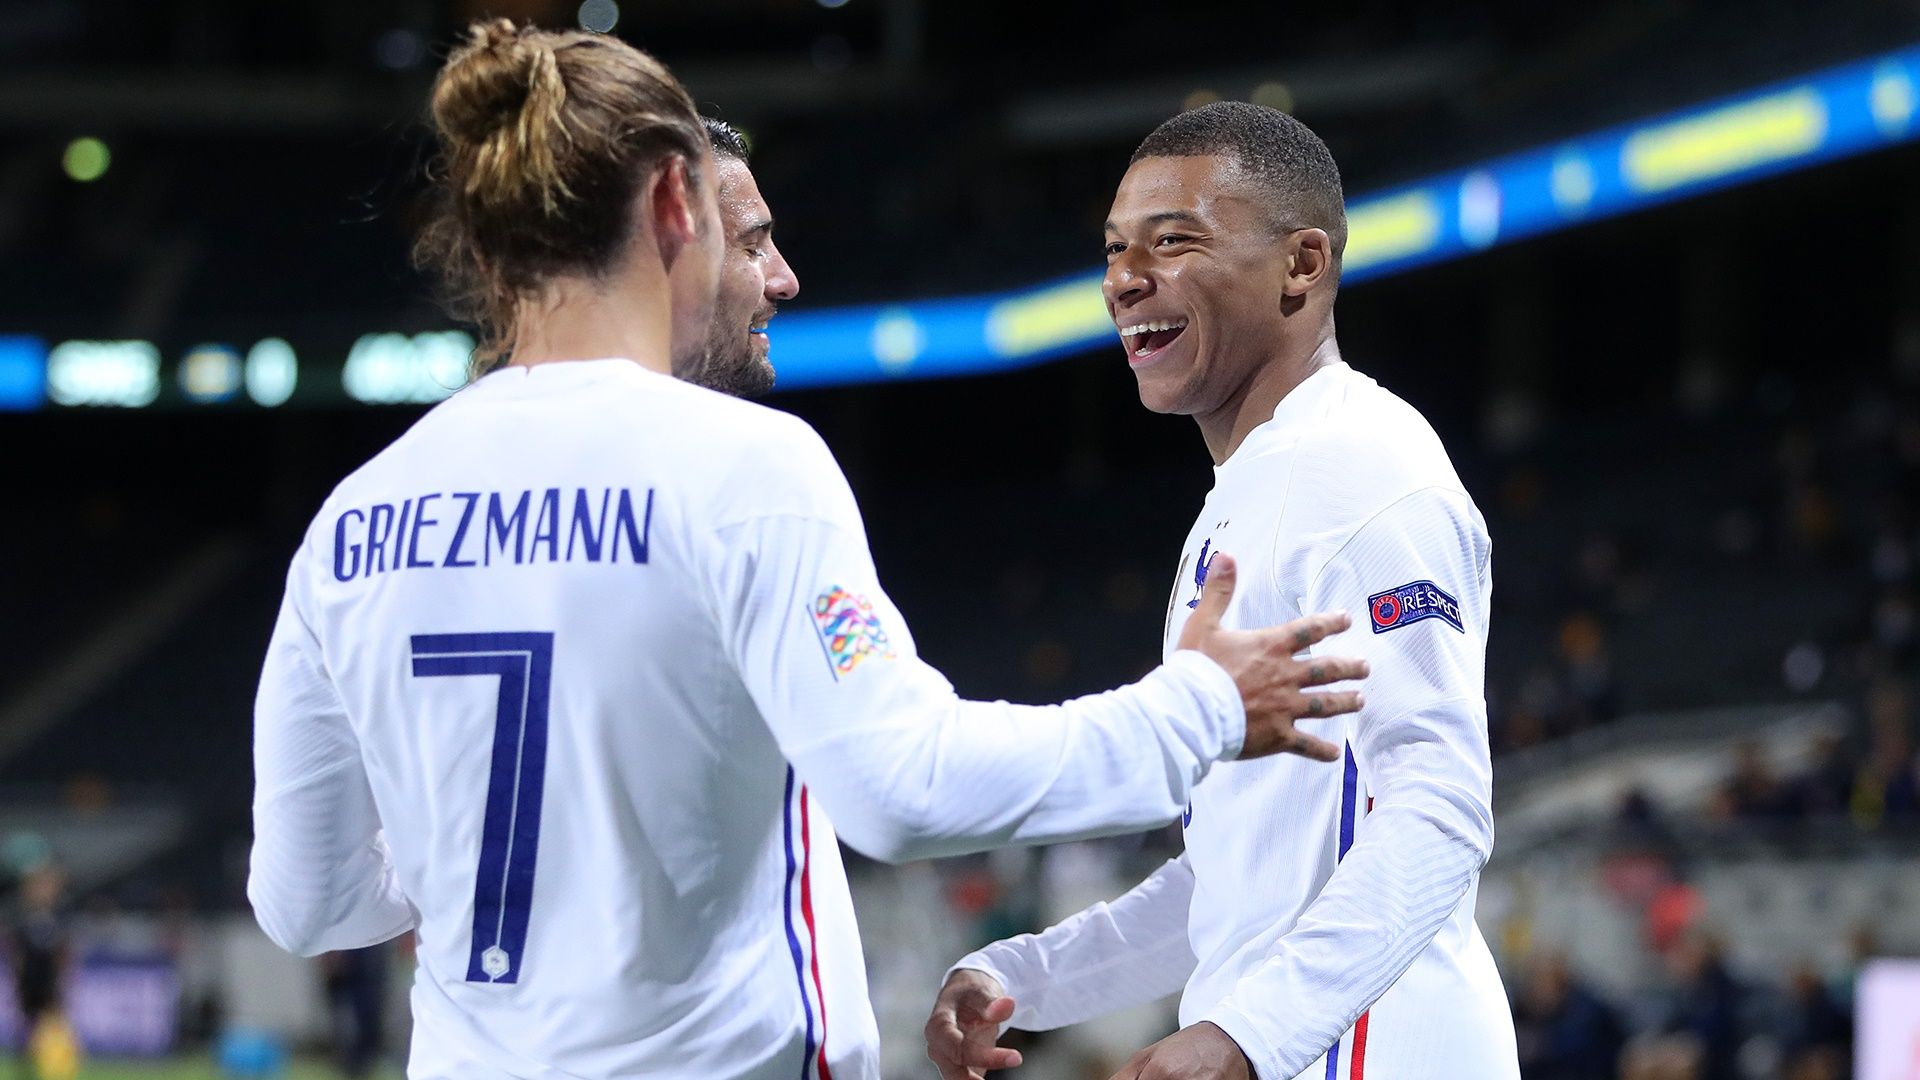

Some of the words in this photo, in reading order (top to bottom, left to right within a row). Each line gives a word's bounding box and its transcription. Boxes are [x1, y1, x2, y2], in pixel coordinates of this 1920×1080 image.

[334, 488, 654, 582] GRIEZMANN
[1403, 591, 1460, 622] RESPECT
[410, 632, 554, 984] 7
